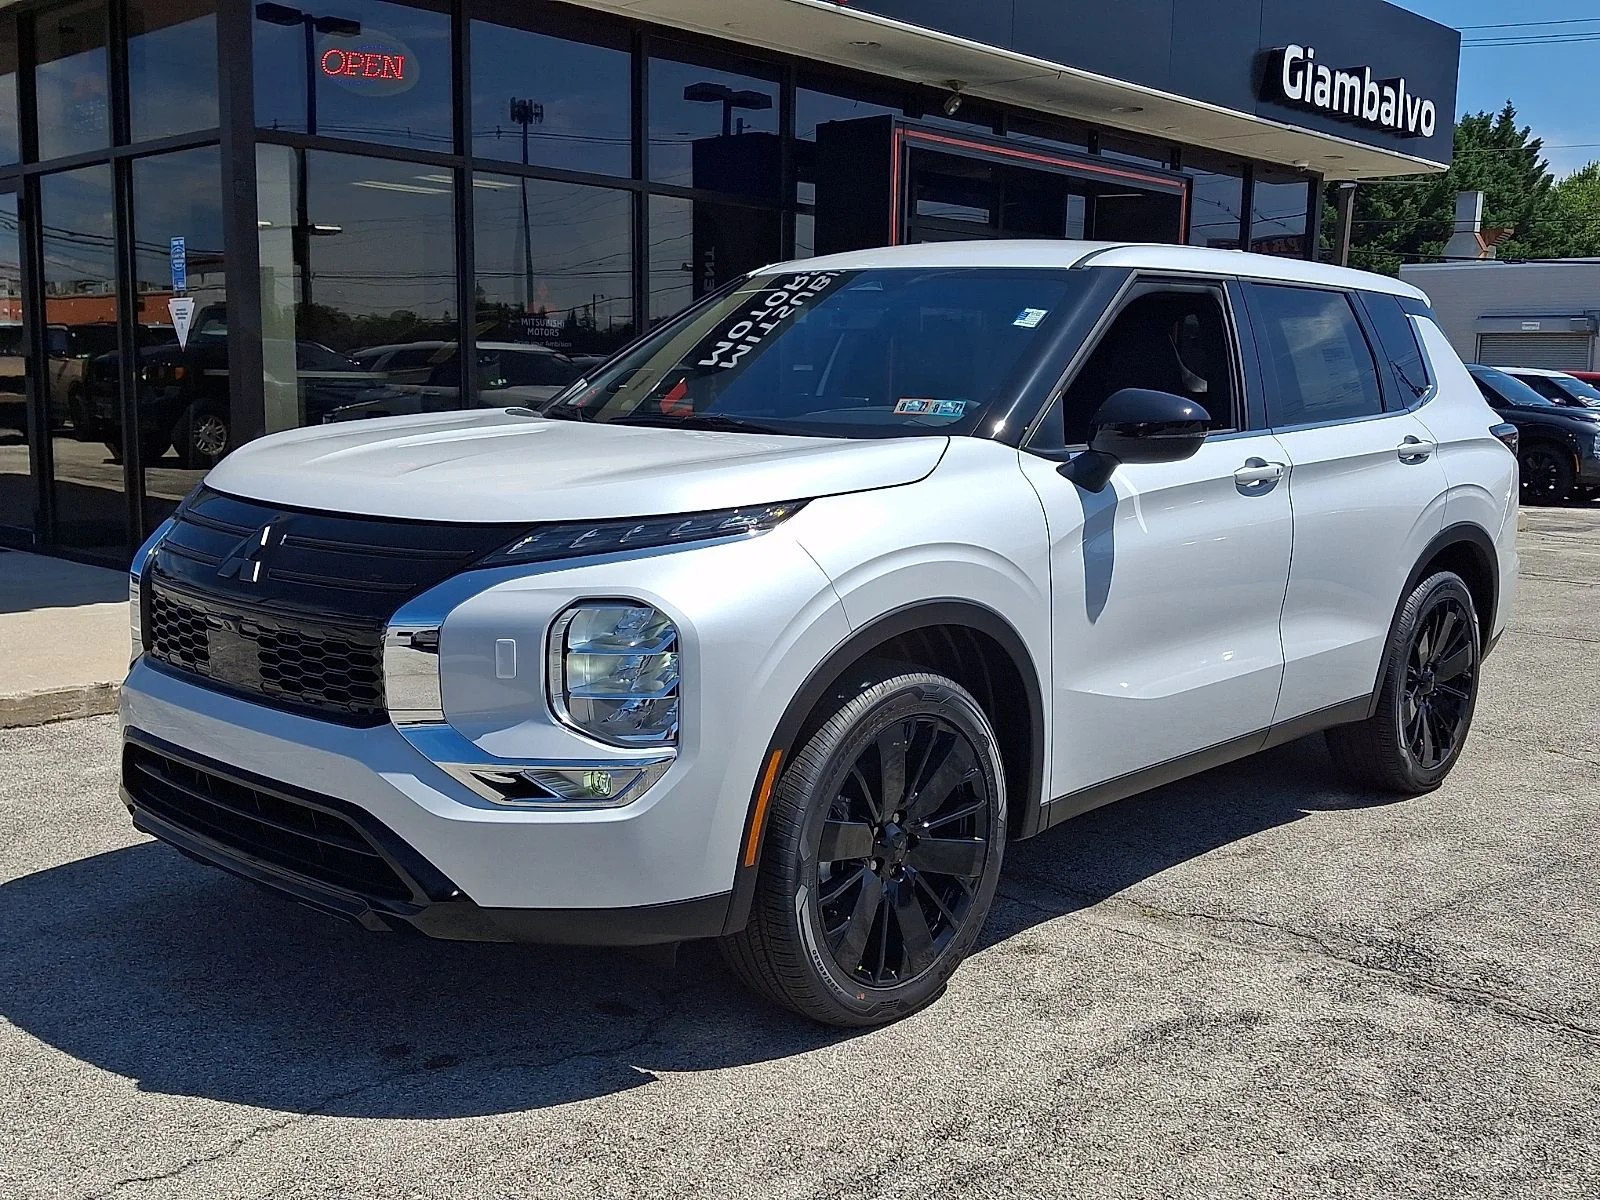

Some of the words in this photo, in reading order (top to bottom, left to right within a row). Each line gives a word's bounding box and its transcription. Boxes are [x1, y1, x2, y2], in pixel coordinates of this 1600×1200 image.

[321, 48, 405, 80] OPEN
[1282, 43, 1436, 138] Giambalvo
[521, 318, 565, 328] MITSUBISHI
[527, 328, 560, 337] MOTORS
[899, 402, 906, 412] 8
[932, 403, 941, 414] 8
